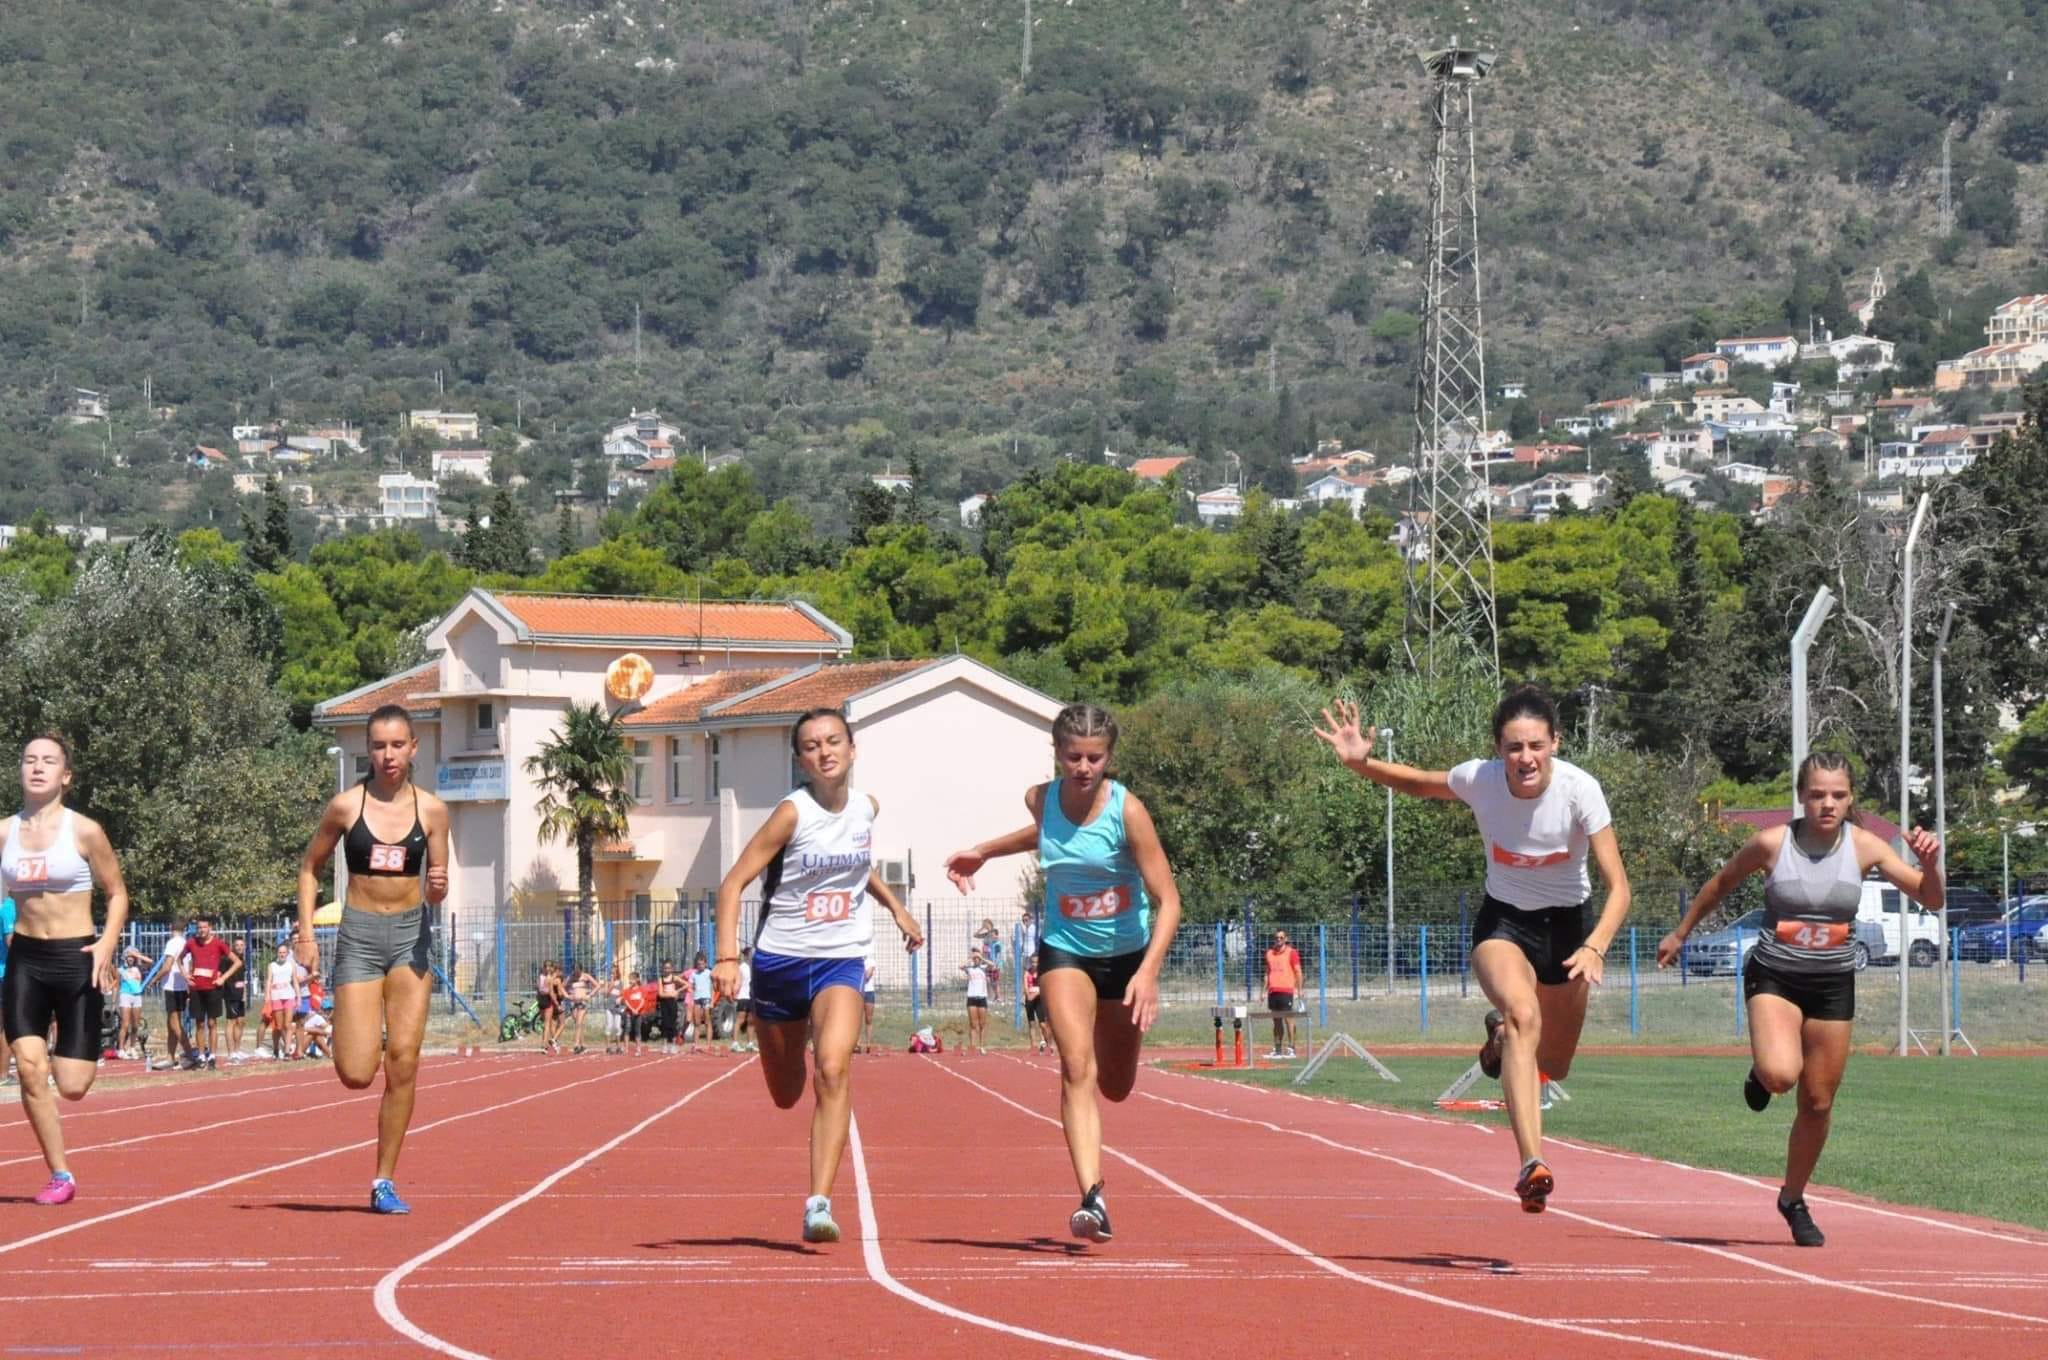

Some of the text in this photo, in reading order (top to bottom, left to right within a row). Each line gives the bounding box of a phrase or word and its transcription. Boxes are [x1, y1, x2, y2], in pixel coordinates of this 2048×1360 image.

[372, 847, 403, 869] 58
[17, 859, 45, 880] 87
[812, 894, 845, 918] 80
[1069, 886, 1120, 918] 229
[1795, 927, 1830, 947] 45
